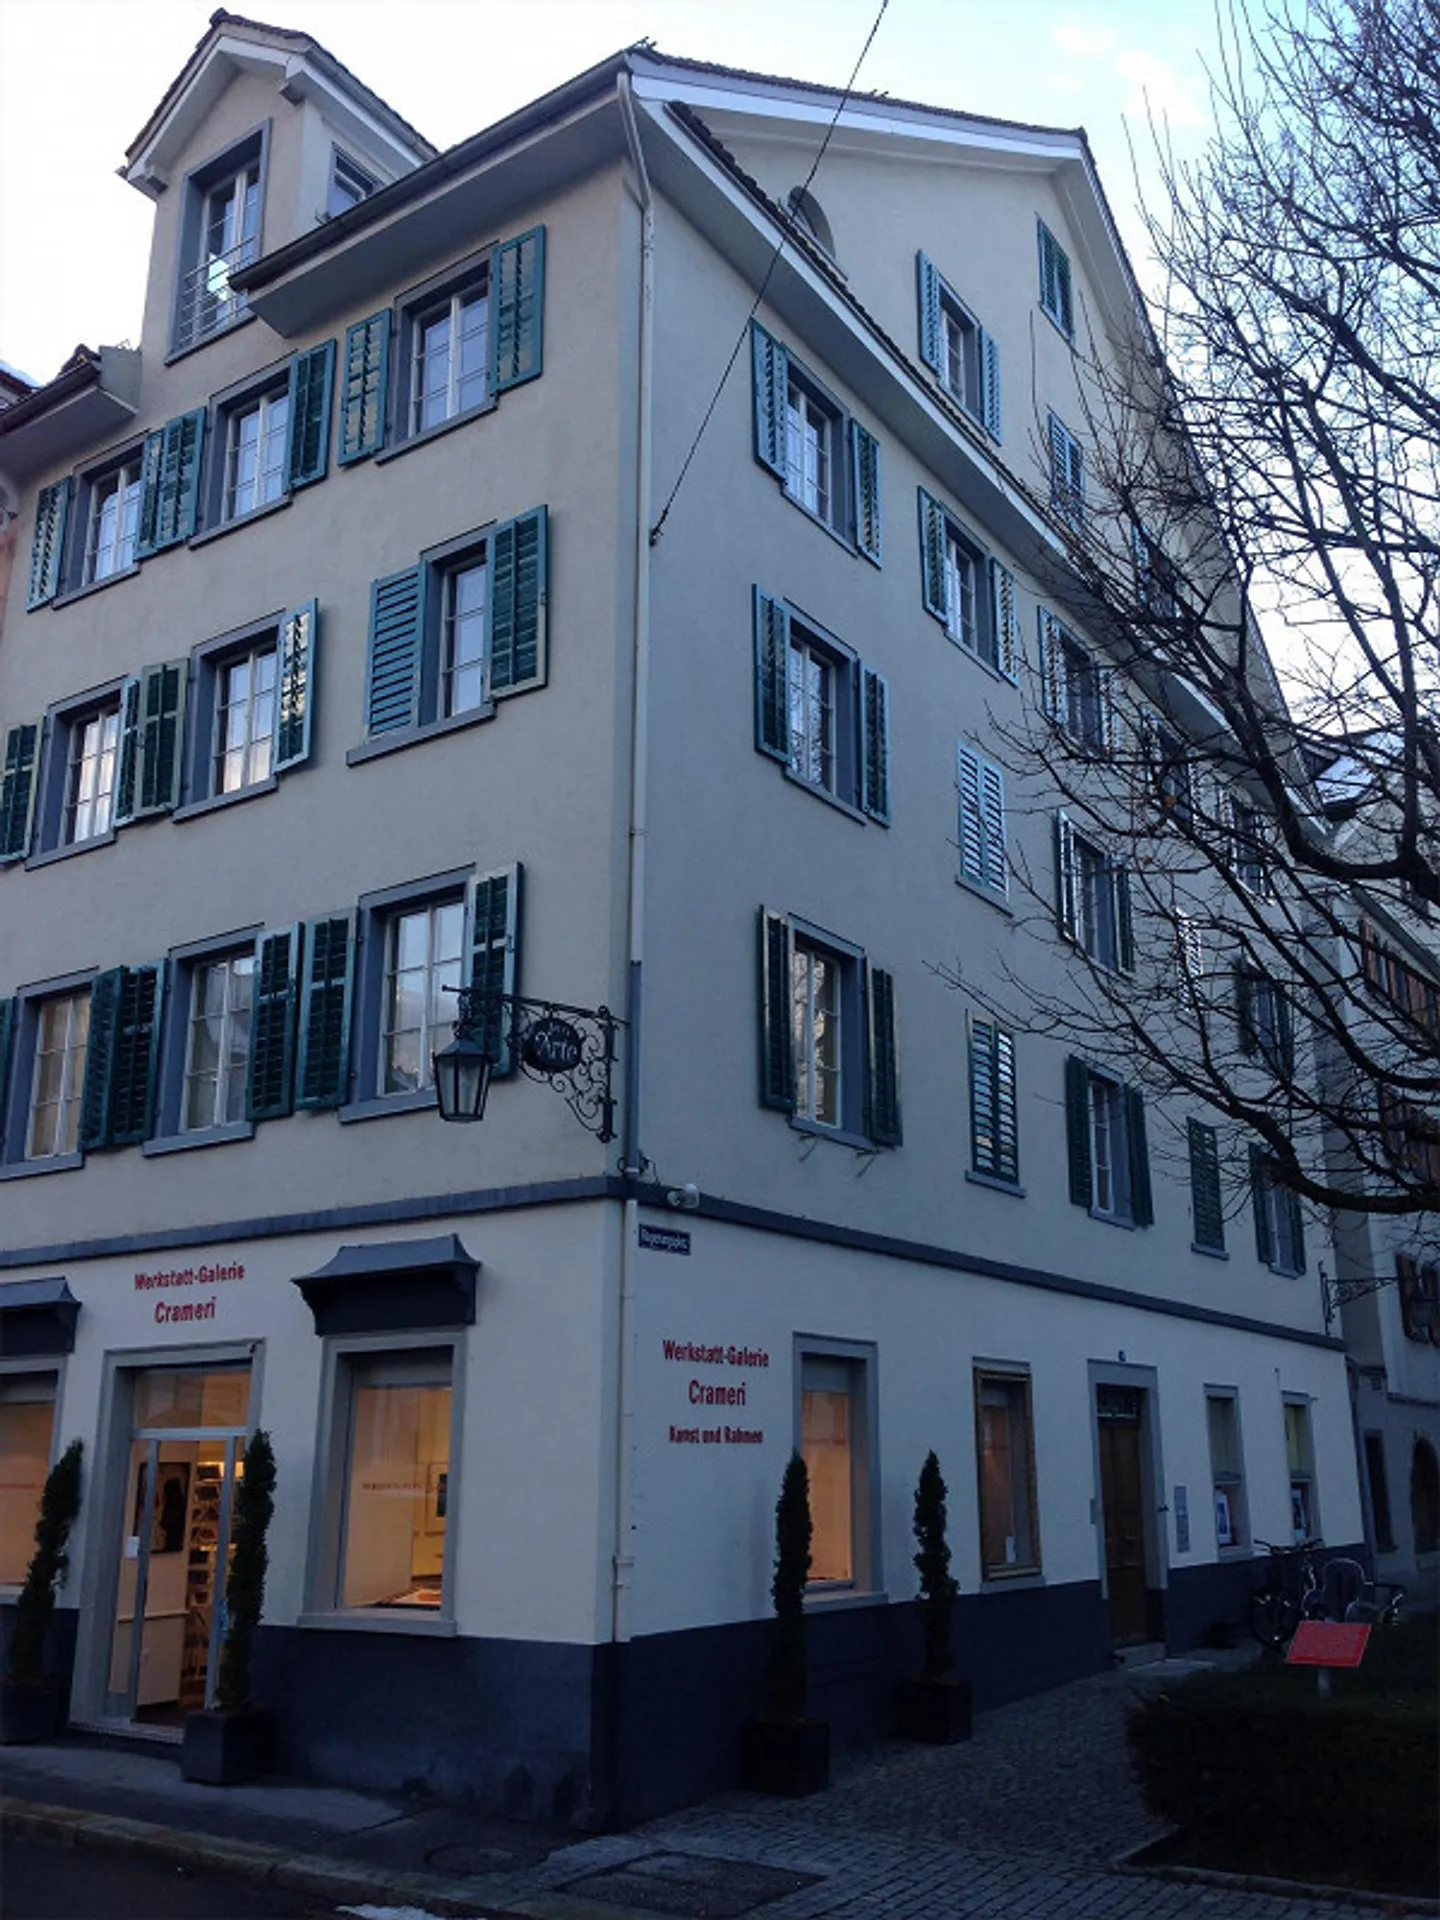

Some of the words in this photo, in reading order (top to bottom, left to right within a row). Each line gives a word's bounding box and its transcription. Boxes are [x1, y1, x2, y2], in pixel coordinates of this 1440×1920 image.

[134, 1262, 245, 1290] Werkstatt-Galerie
[155, 1296, 216, 1323] Crameri
[662, 1340, 769, 1367] Werkstatt-Galerie
[688, 1379, 746, 1406] Crameri
[669, 1425, 700, 1443] Kunst
[702, 1426, 722, 1443] und
[724, 1425, 764, 1443] Rahmen
